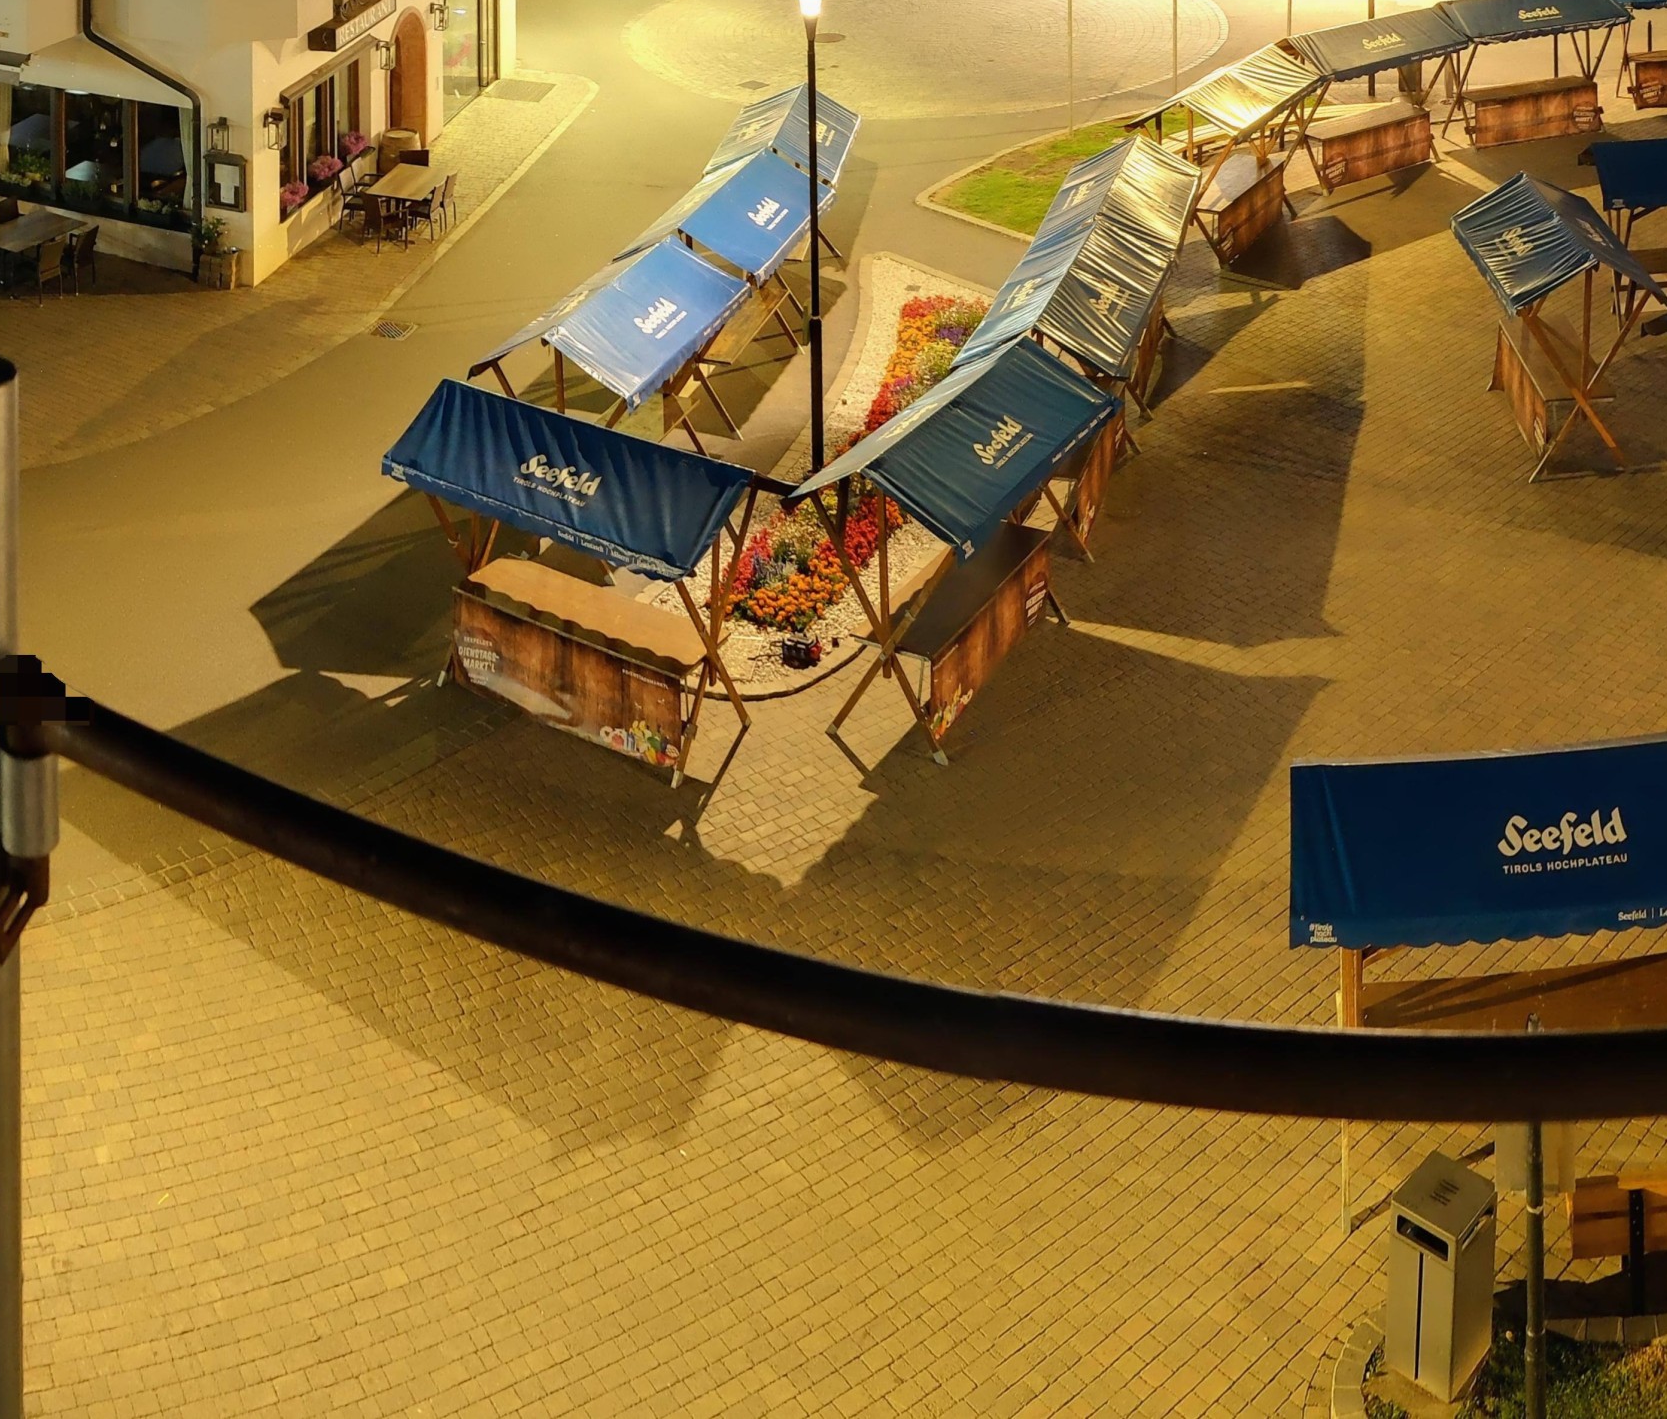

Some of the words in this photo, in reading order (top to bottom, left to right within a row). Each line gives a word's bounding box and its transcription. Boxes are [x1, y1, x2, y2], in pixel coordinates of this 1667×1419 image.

[1518, 5, 1560, 21] Seefeld
[1362, 32, 1402, 51] Seefeld
[972, 414, 1024, 466] Seefeld
[520, 454, 603, 497] Seefeld
[1498, 807, 1629, 857] Seefeld
[1503, 862, 1543, 874] TIROLS
[1546, 853, 1629, 870] HOCHPLATEAU
[1617, 908, 1648, 921] Seefeld
